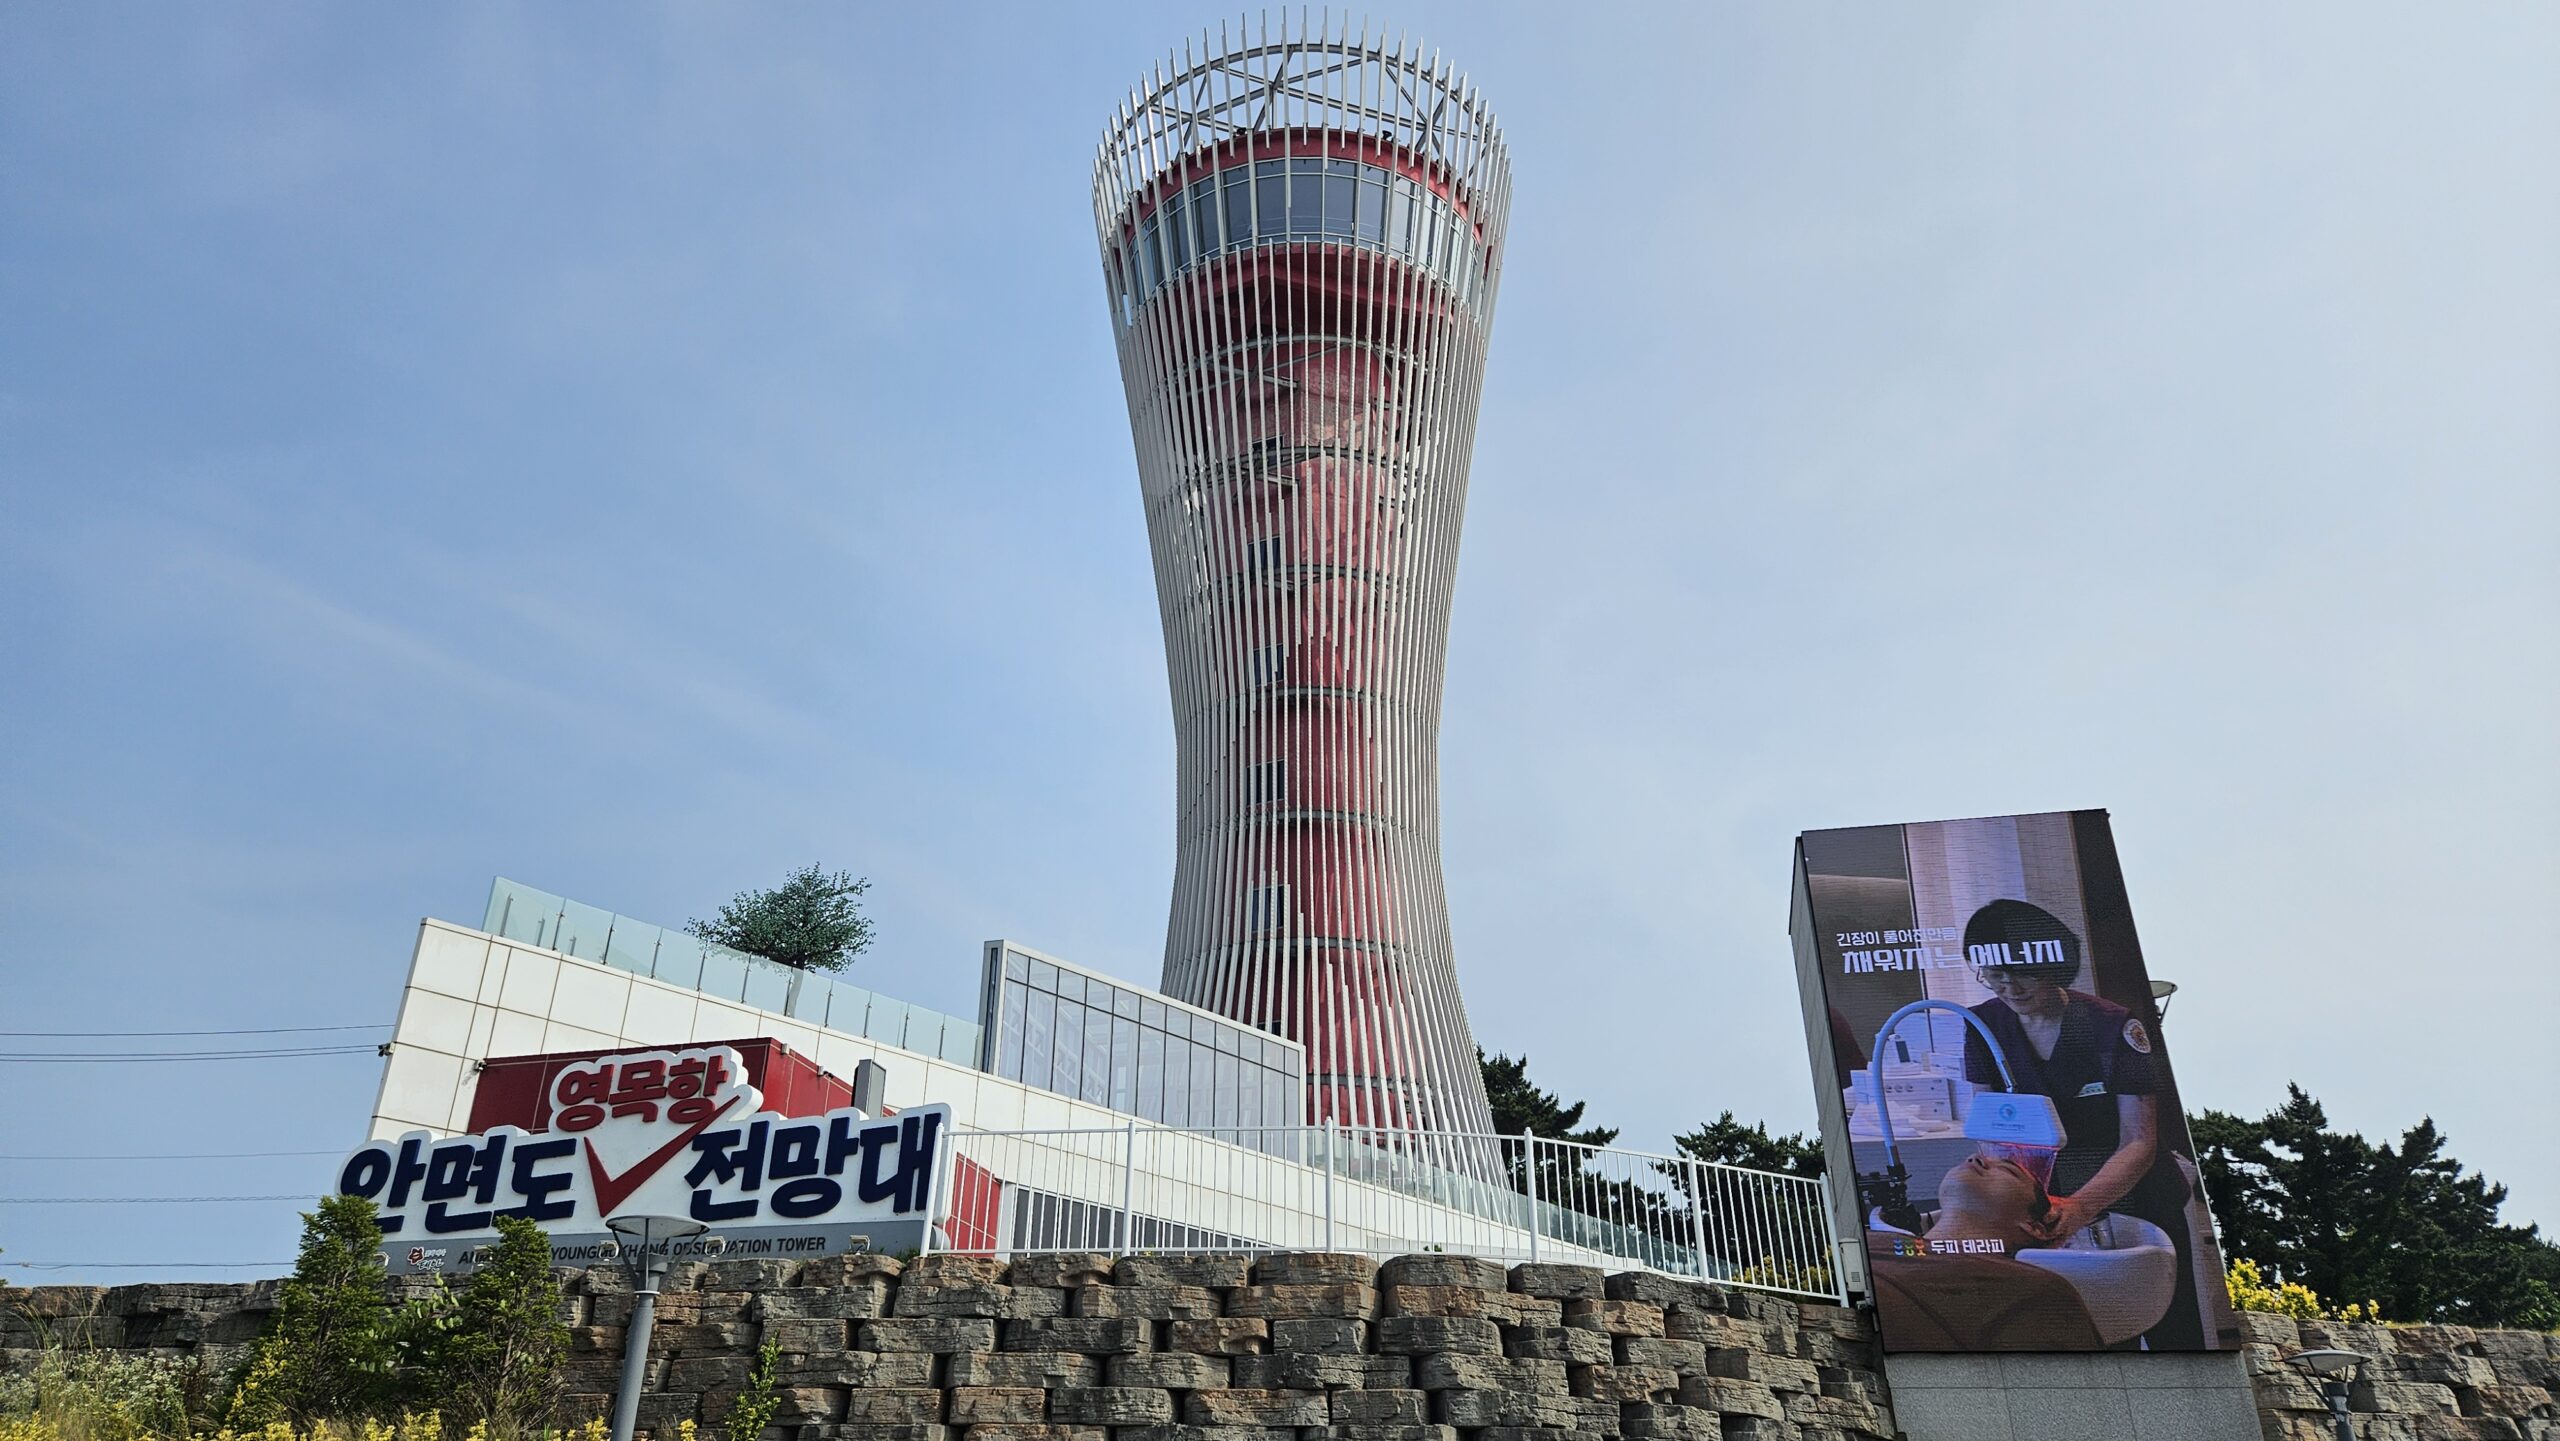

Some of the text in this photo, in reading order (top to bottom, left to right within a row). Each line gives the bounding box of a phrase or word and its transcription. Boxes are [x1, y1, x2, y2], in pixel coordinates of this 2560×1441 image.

[1836, 927, 1957, 947] 긴장이 풀어진만큼
[1842, 939, 2065, 974] 채워지는 에너지
[556, 1055, 729, 1132] 영목항
[340, 1112, 942, 1234] 안면도 전망대
[777, 1236, 826, 1252] TOWER
[1930, 1238, 2005, 1254] 두피 테라피
